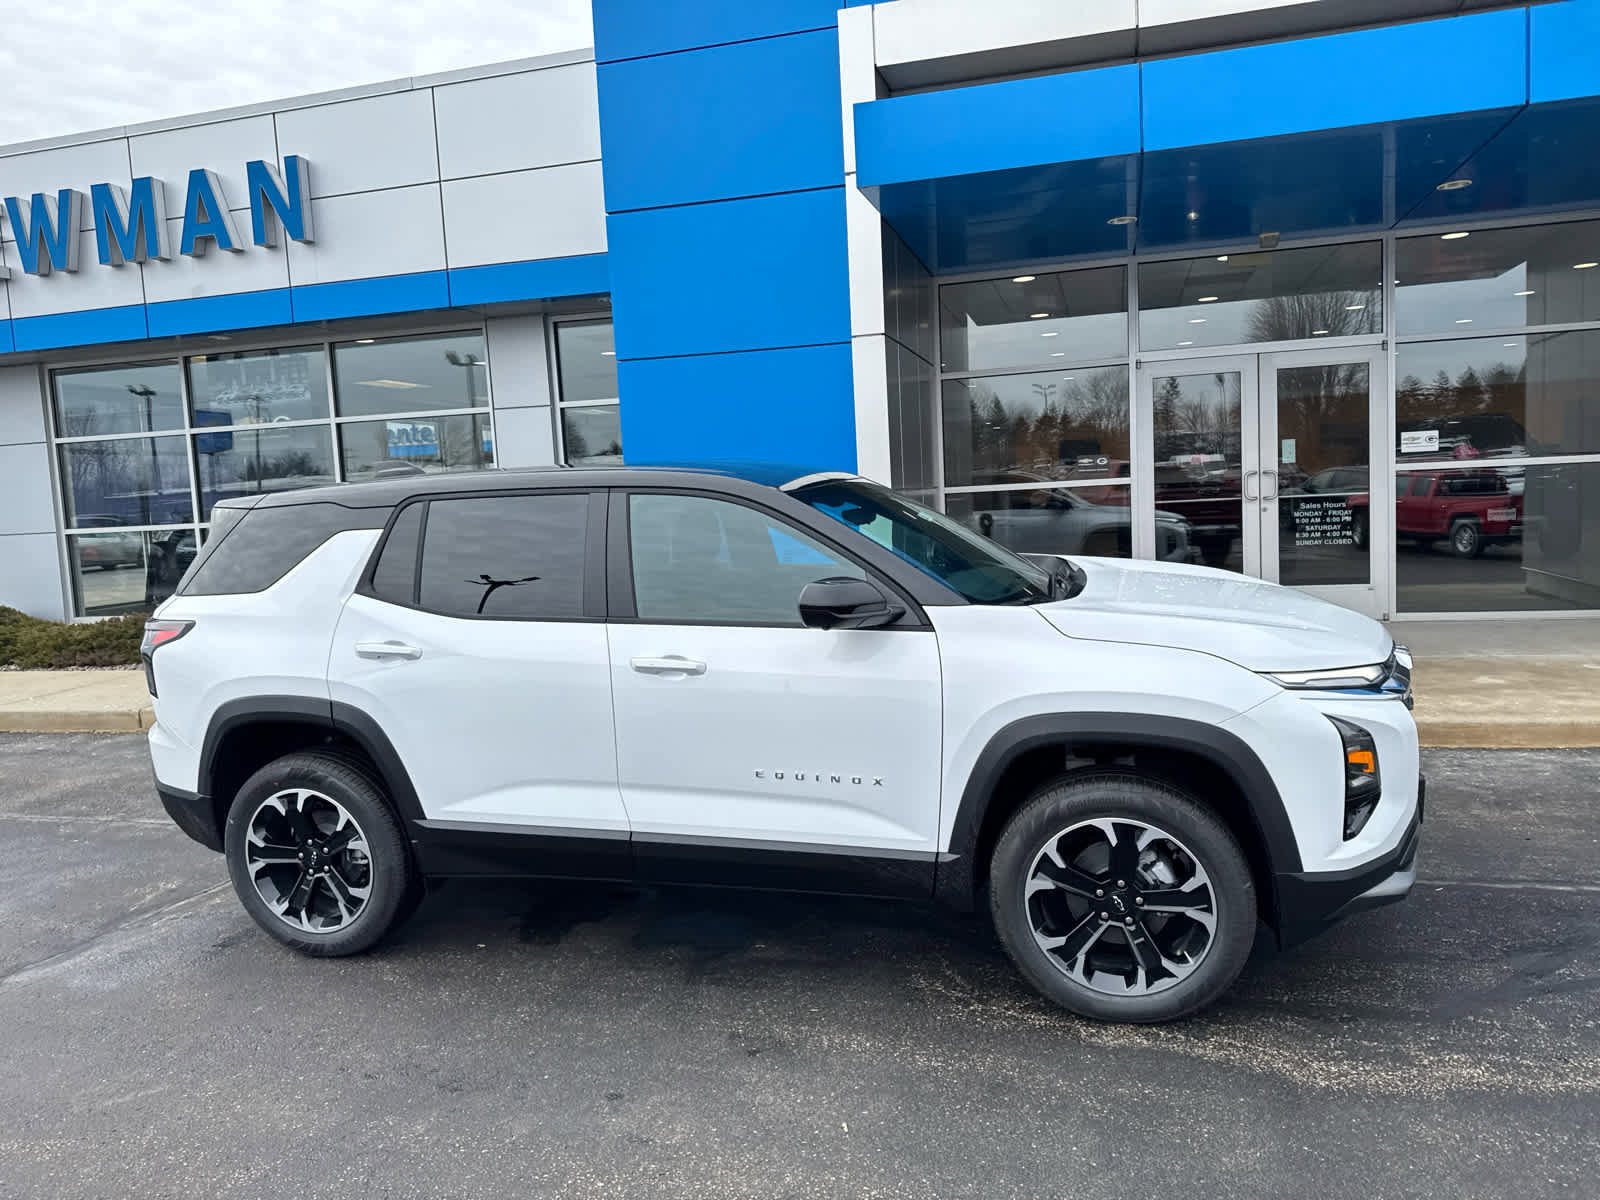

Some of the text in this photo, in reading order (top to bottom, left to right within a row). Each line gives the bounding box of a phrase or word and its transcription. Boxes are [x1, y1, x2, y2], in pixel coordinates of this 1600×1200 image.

[0, 154, 314, 276] WMAN
[1323, 501, 1346, 509] Hours
[755, 770, 883, 787] EQUINOX
